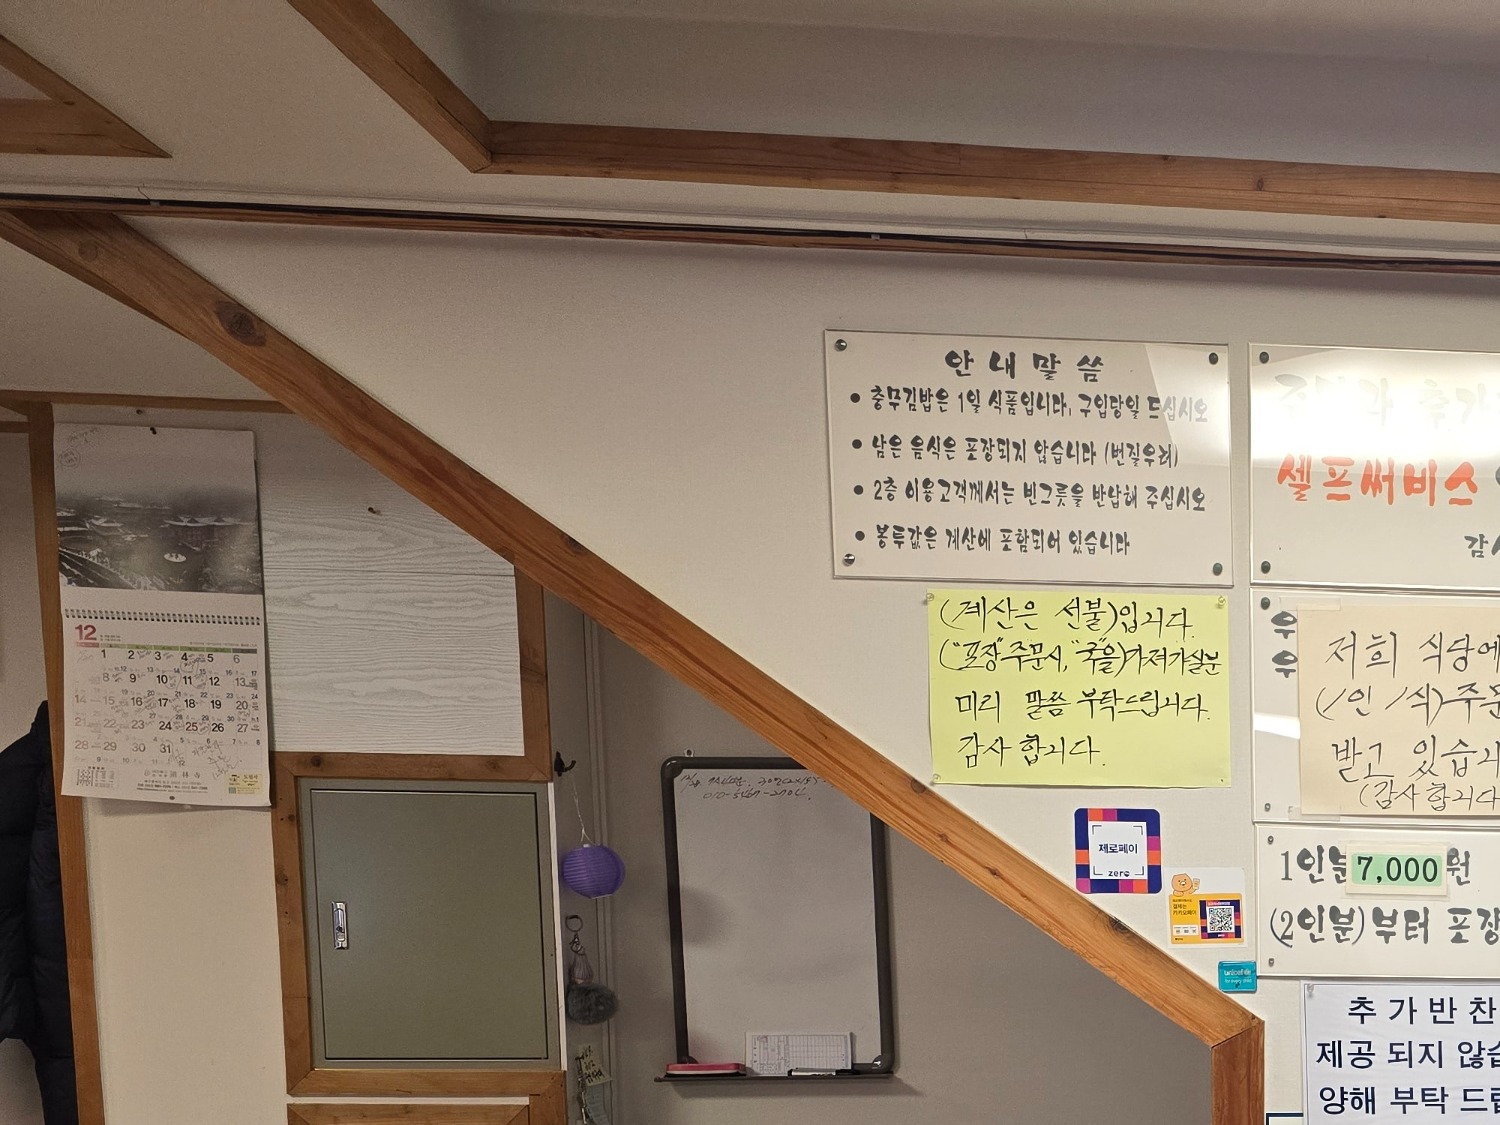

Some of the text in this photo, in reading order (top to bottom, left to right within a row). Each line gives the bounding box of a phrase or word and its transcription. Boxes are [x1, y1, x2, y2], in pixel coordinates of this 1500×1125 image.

[870, 385, 949, 414] 충무김밥은
[958, 390, 981, 415] 1일
[1079, 393, 1140, 420] 구입당일
[1147, 394, 1208, 422] 드십시오
[872, 434, 902, 459] 남은
[911, 435, 956, 460] 음식은
[965, 437, 1026, 463] 포장되지
[1034, 440, 1096, 465] 않습니다
[874, 476, 1205, 511] 2층 이용고객께서는 빈그릇을 반납해 주십시오
[1277, 453, 1479, 507] 셀프써비스
[876, 524, 1130, 555] 봉투값은 계산에 포함되어 있습니다
[940, 596, 1038, 633] (계산은
[75, 625, 97, 641] 12
[128, 651, 240, 663] 2 3 4 5 6
[1325, 631, 1397, 679] 저희
[129, 674, 246, 686] 9 10 11 12 13
[131, 697, 248, 710] 16 17 18 19 20
[955, 690, 1000, 723] 미리
[1025, 689, 1071, 721] 말씀
[132, 720, 248, 732] 23 24 25 26 27
[104, 742, 170, 753] 29 31
[1332, 736, 1394, 783] 받고
[1099, 843, 1138, 854] 제로페이
[1357, 855, 1439, 884] 7,000
[1447, 847, 1471, 886] 원
[1316, 1040, 1376, 1069] 제공
[1388, 1039, 1444, 1069] 되지
[1319, 1086, 1376, 1115] 양해
[1390, 1086, 1449, 1114] 부탁
